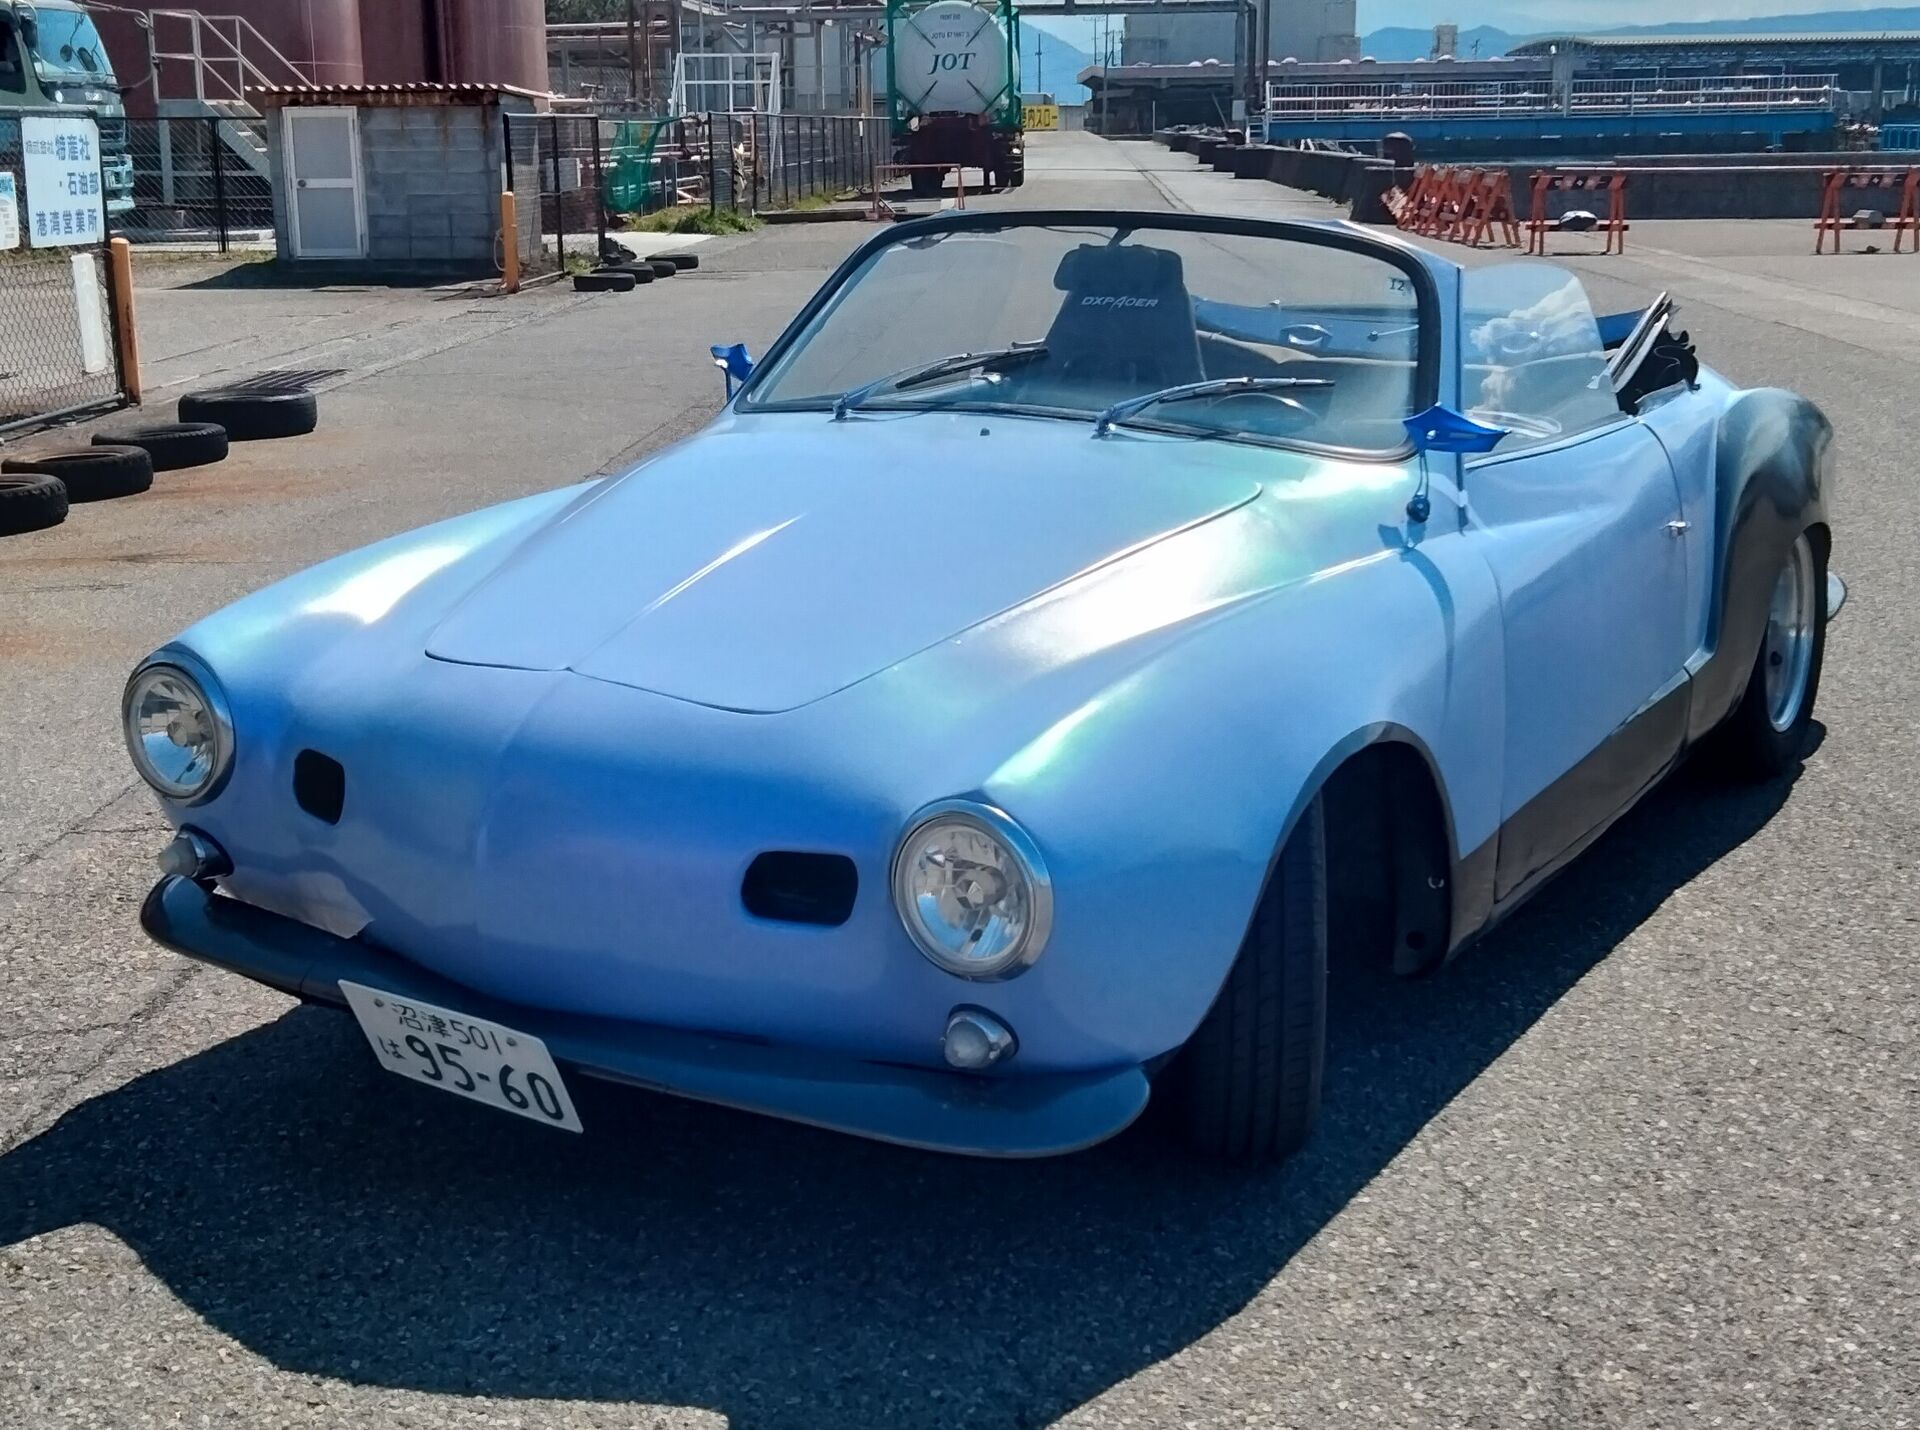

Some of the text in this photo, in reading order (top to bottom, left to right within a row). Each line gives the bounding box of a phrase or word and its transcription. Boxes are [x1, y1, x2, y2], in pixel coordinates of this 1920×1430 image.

[927, 52, 976, 75] JOT
[35, 208, 97, 237] 港湾営業所
[404, 1034, 564, 1121] 95-60
